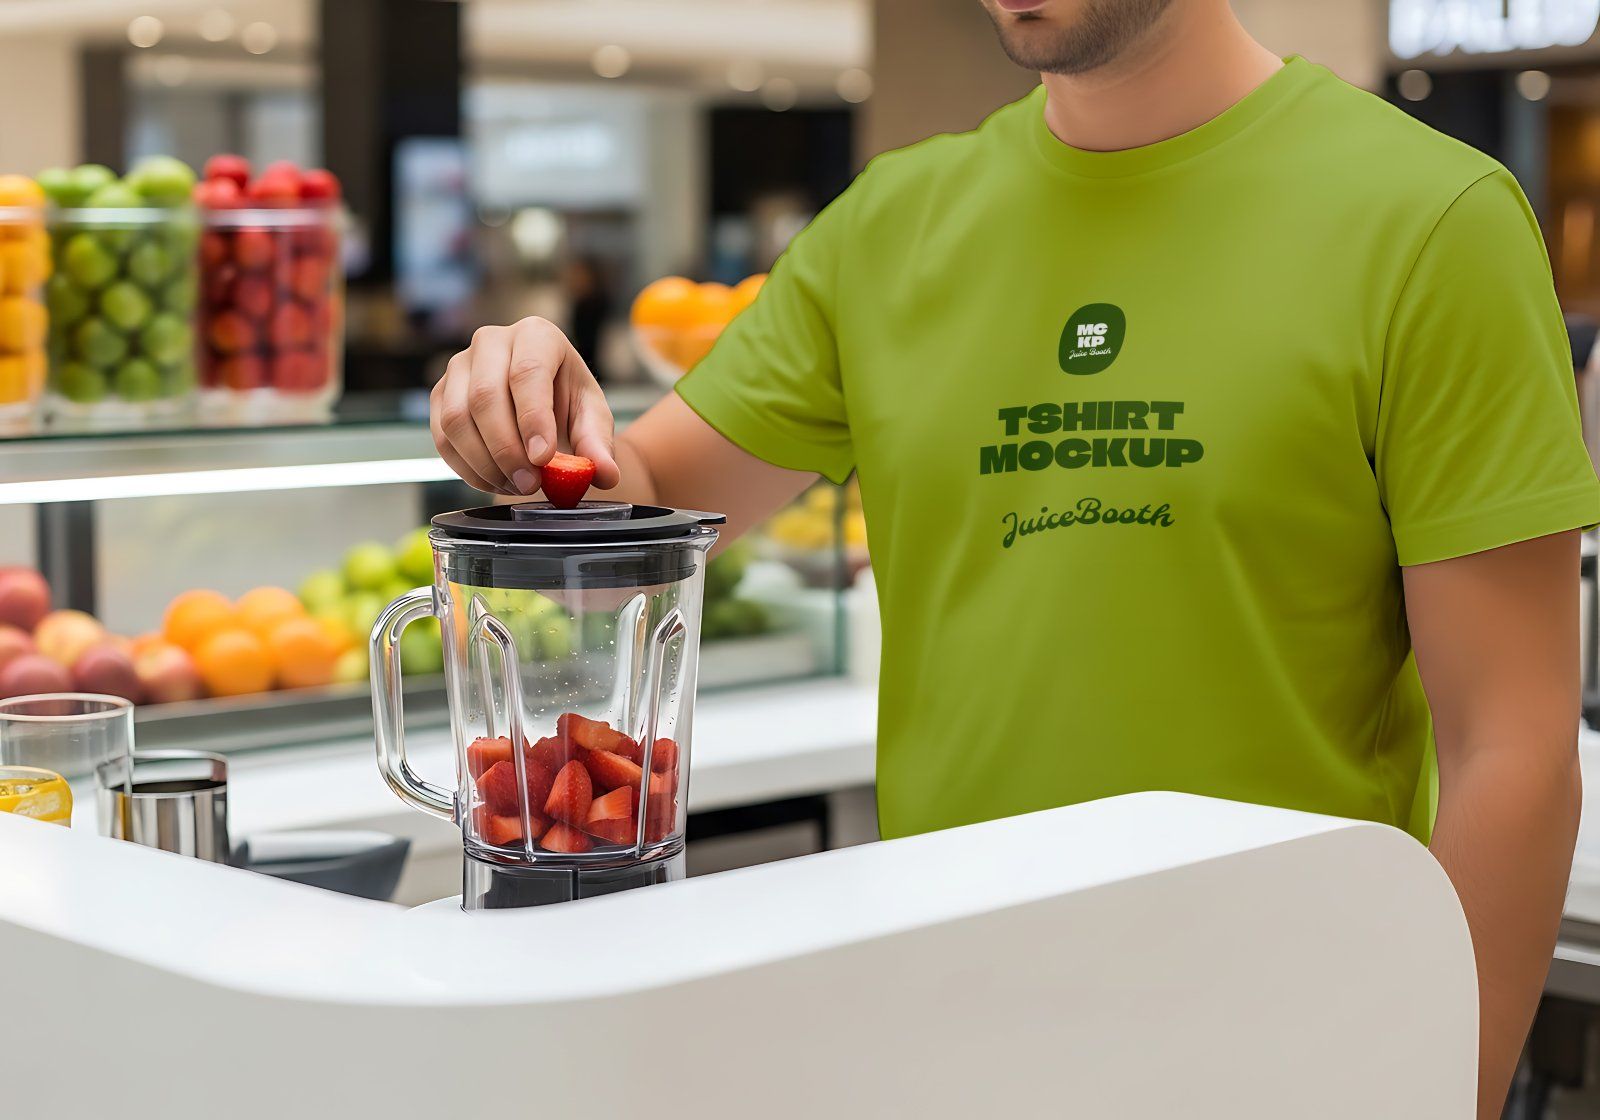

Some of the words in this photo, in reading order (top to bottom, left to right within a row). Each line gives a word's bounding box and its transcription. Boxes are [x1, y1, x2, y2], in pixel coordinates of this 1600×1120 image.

[1077, 323, 1108, 336] MC
[1077, 336, 1105, 348] KP
[1069, 350, 1087, 359] Juice
[1089, 347, 1111, 356] Booth
[998, 401, 1184, 436] TSHIRT
[980, 438, 1204, 475] MOCKUP
